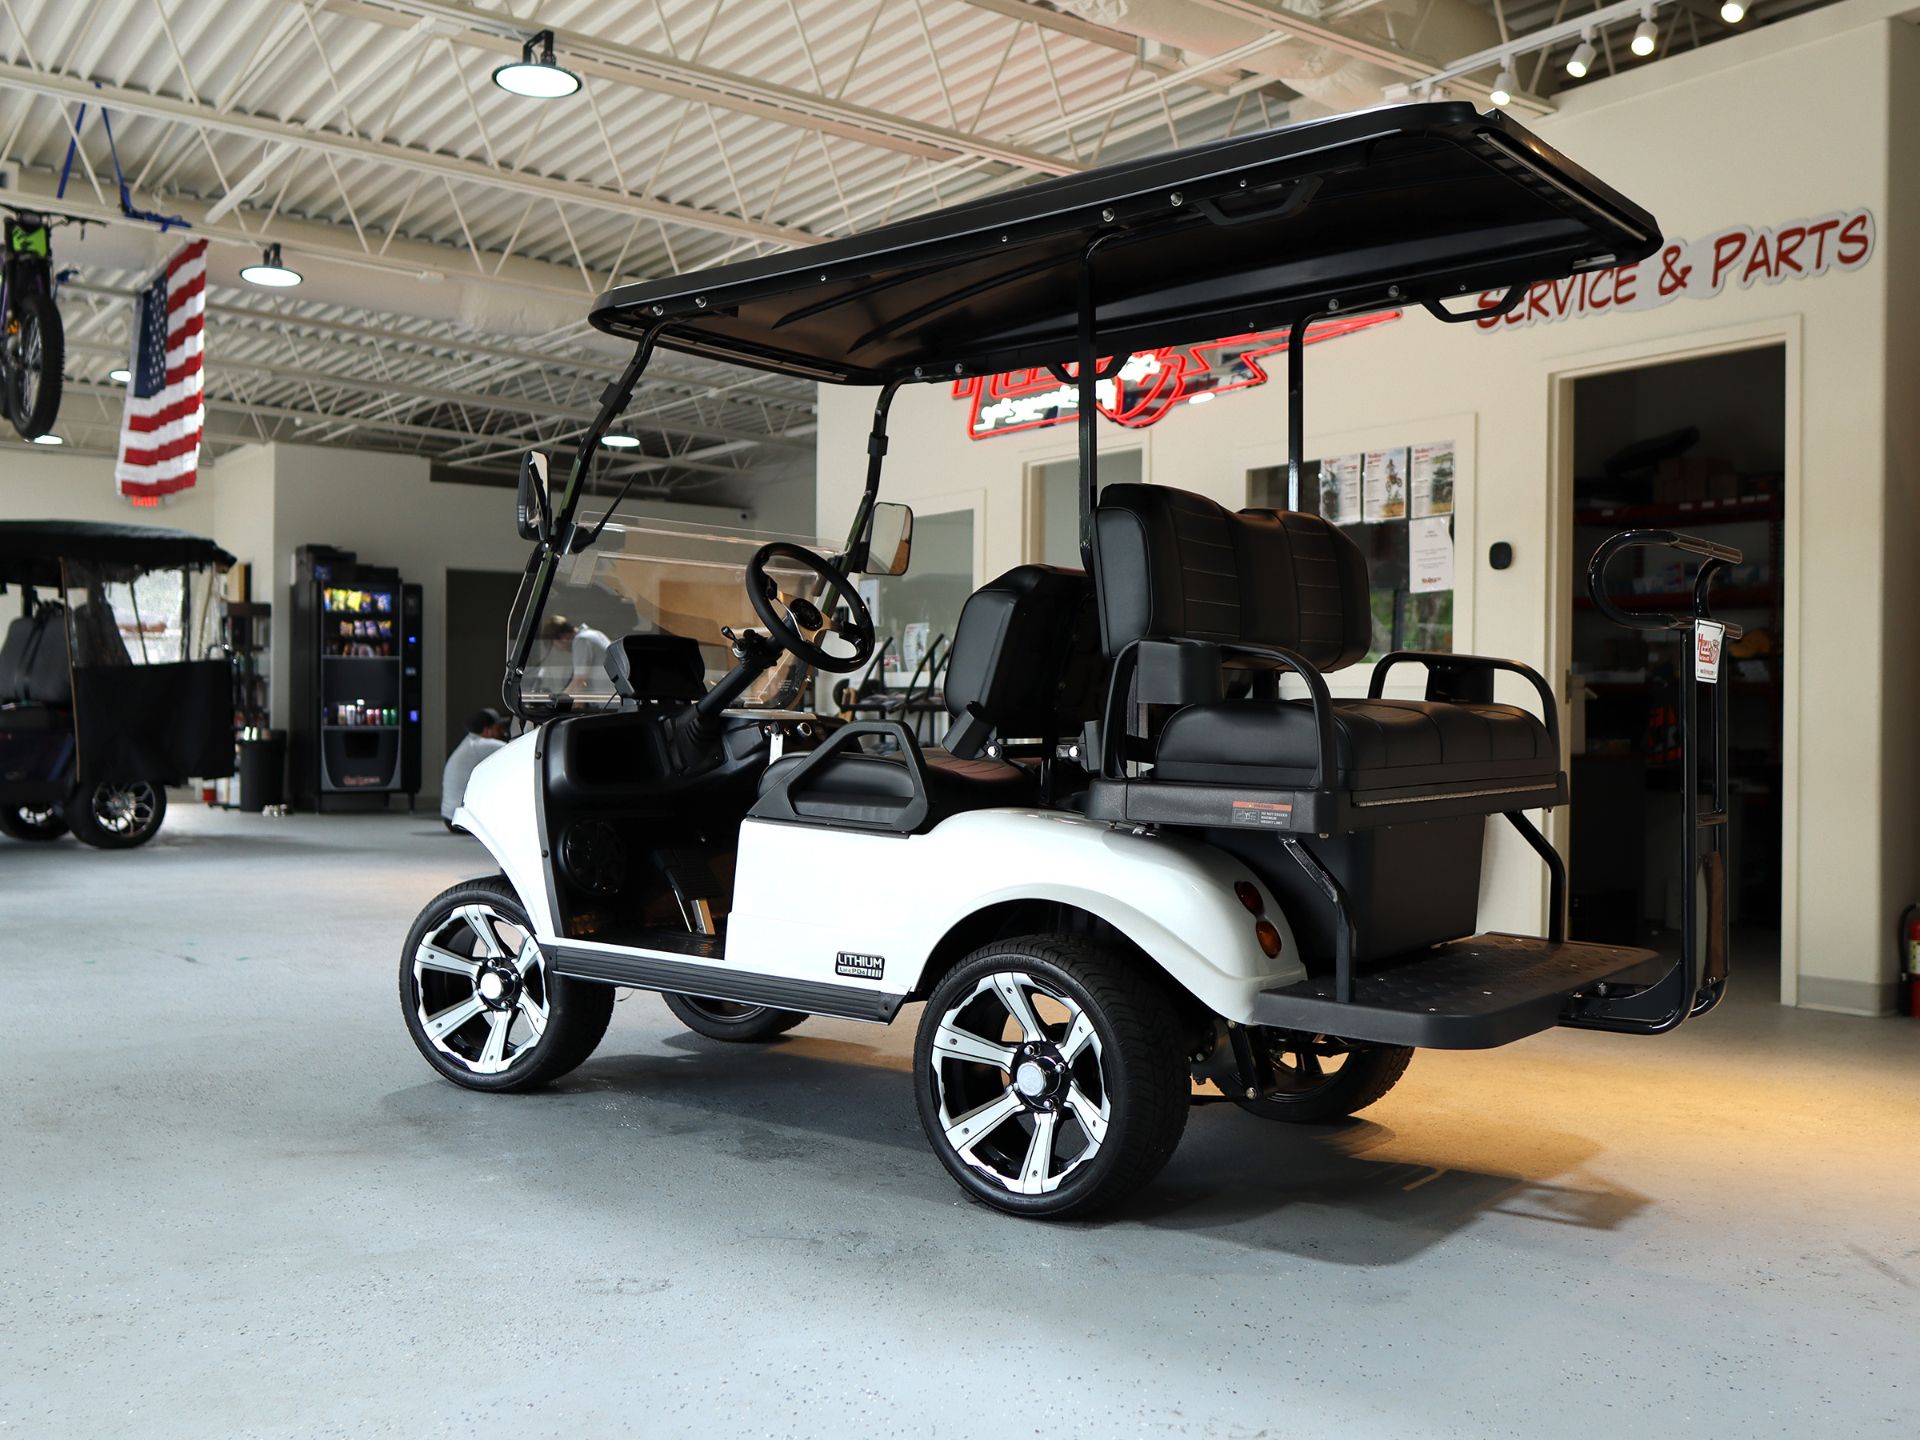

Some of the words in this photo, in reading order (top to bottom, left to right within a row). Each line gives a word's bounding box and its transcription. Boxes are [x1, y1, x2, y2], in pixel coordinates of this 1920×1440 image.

[1658, 245, 1692, 296] &
[1711, 214, 1869, 288] PARTS
[838, 954, 882, 968] LITHIUM
